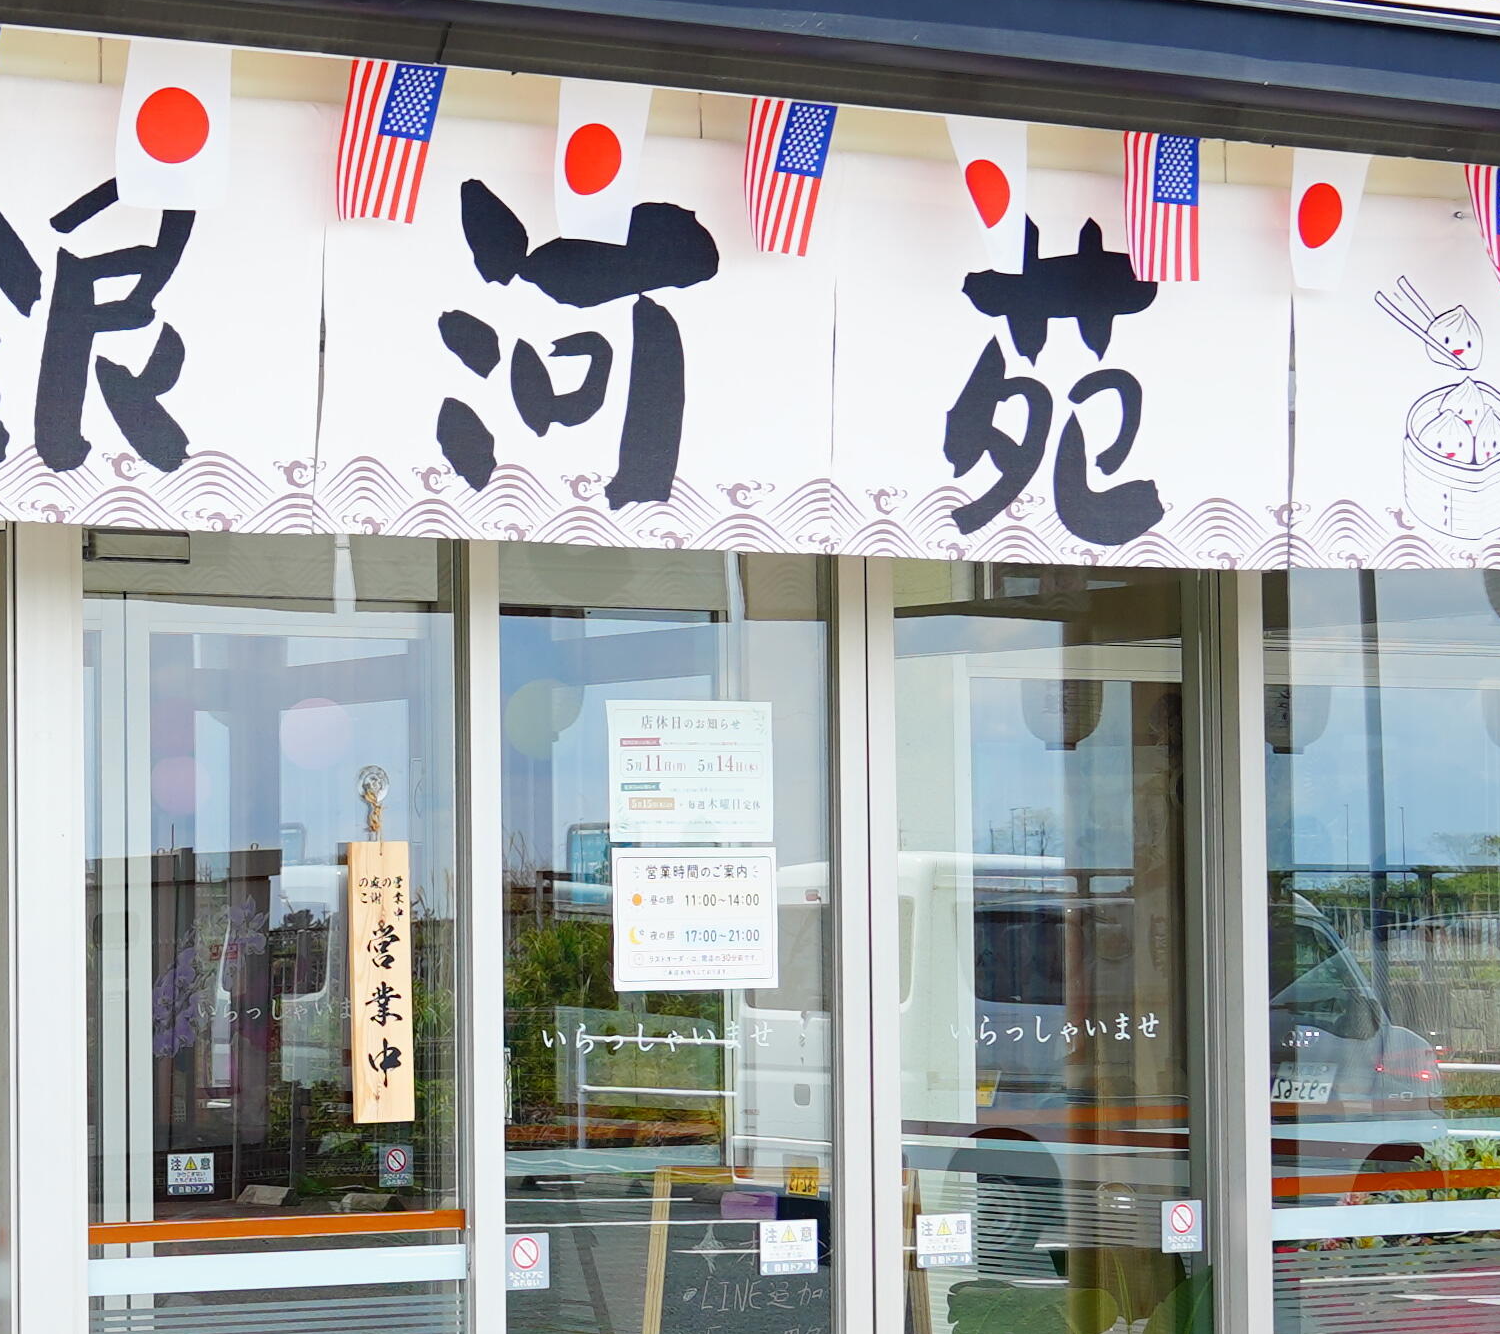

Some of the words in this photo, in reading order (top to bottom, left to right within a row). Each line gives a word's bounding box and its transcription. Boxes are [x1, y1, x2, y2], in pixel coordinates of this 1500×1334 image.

[640, 714, 741, 731] 店休日のお知らせ
[645, 864, 748, 880] 営業時間のご案内
[365, 921, 404, 1089] 営業中
[541, 1020, 774, 1055] いらっしゃいませ
[950, 1012, 1160, 1046] いらっしゃいませ
